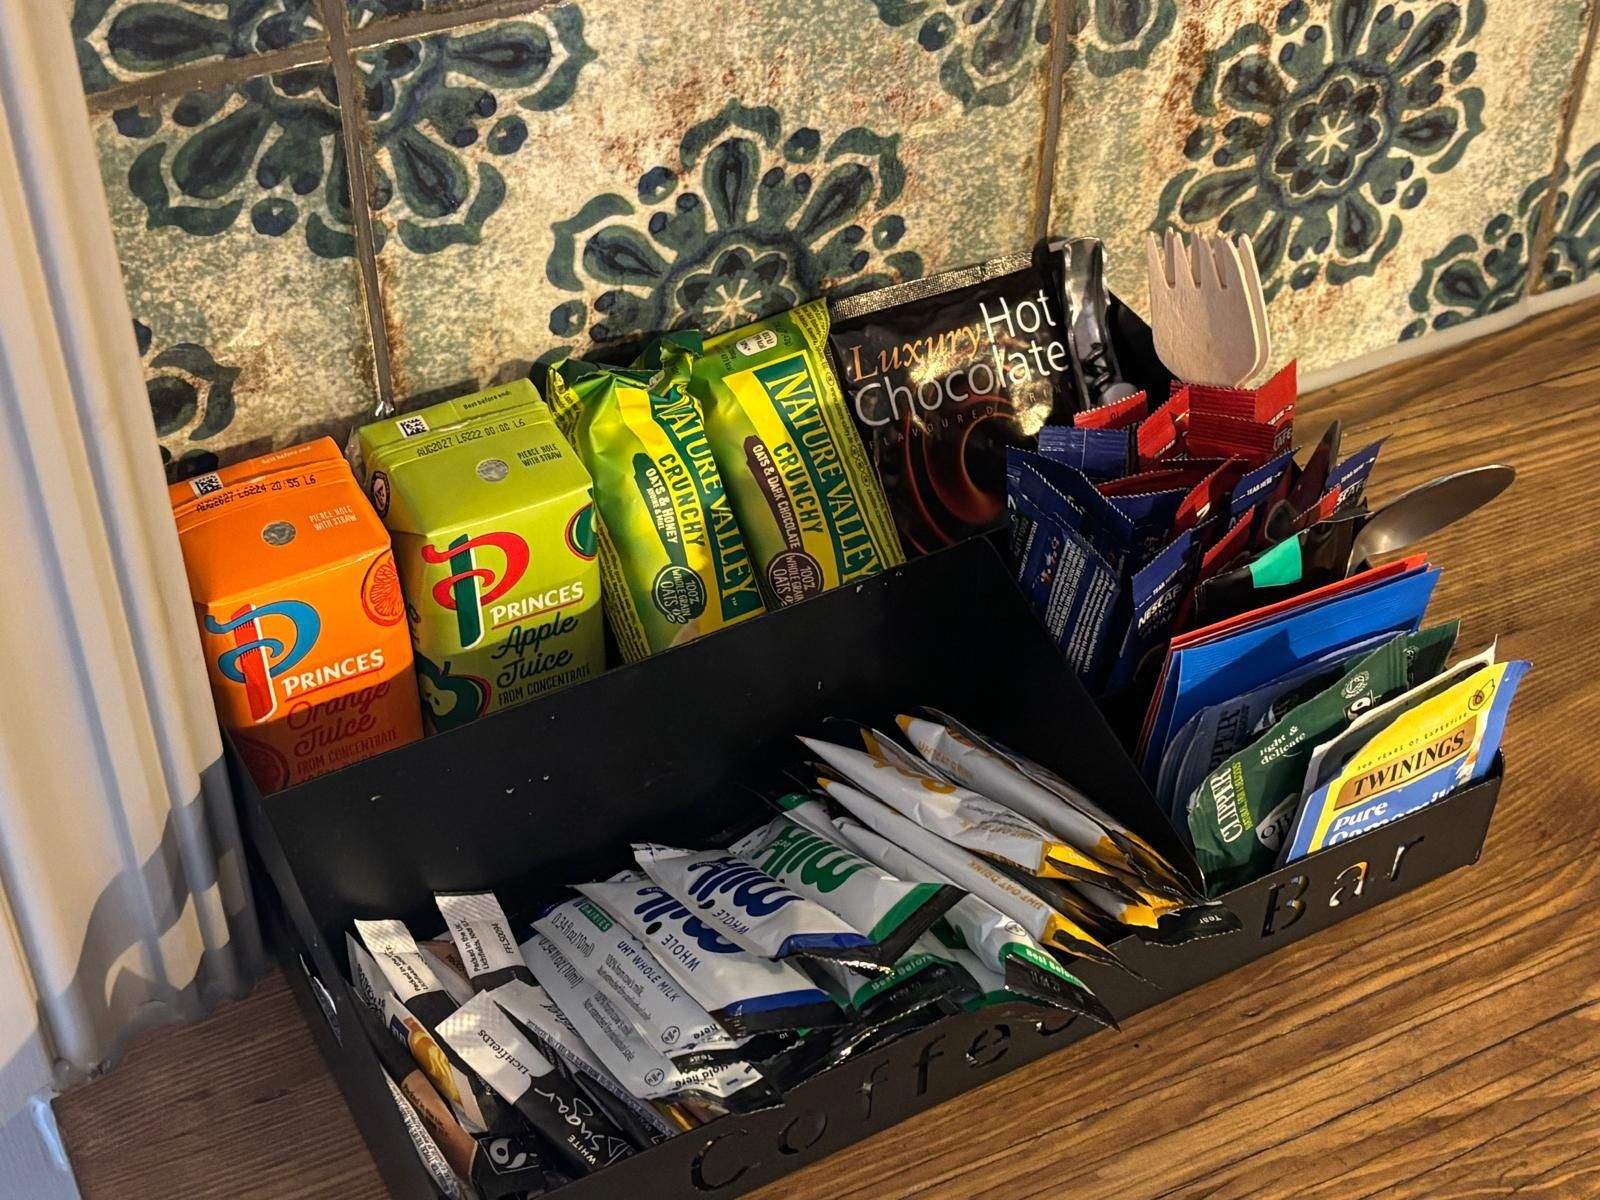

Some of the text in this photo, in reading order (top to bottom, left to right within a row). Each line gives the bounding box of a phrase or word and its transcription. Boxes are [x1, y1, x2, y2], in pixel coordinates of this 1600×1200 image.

[979, 289, 1057, 344] Hot
[850, 323, 982, 383] Luxury
[855, 339, 1069, 427] Chocolate
[869, 406, 994, 450] FLAVOURED
[517, 447, 540, 460] PIERCE
[521, 450, 564, 468] WITH STRAW
[654, 397, 758, 601] NATURE VALLEY
[752, 444, 802, 551] OATS & DARK CHOCOLATE
[765, 369, 843, 484] NATURE
[827, 479, 881, 585] VALLEY
[773, 442, 824, 534] CRUNCHY
[645, 467, 679, 545] OATS & HONEY
[658, 453, 706, 547] CRUNCHY
[772, 568, 789, 595] OATS
[785, 555, 799, 581] WHOLE
[490, 581, 585, 625] PRINCES
[660, 580, 676, 606] OATS
[490, 611, 579, 660] Apple
[281, 648, 385, 697] PRINCES
[496, 649, 574, 689] Juice
[498, 663, 592, 706] FROM CONCENTRATE
[287, 680, 393, 731] Orange
[293, 712, 377, 757] Juice
[296, 755, 326, 776] FROM
[328, 727, 398, 764] CONCENTRATE
[1260, 725, 1299, 757] light &
[1260, 732, 1307, 766] delicate
[1377, 744, 1404, 762] YEARS
[1408, 737, 1420, 748] OF
[1424, 713, 1469, 740] EXPERTISE
[1354, 729, 1465, 798] TWININGS
[1210, 768, 1243, 843] CLIPPER
[968, 860, 1044, 910] UHT OAT DRINK
[1261, 836, 1425, 938] Bar
[551, 912, 570, 931] 0.34
[578, 903, 613, 932] DAIRIES
[713, 909, 751, 935] WHOLE
[466, 948, 479, 972] Packed
[617, 939, 679, 1003] UHT WHOLE MILK
[661, 932, 701, 973] WHOLE
[402, 971, 420, 993] Packed
[693, 1023, 720, 1041] here
[675, 1072, 702, 1087] here
[689, 1053, 715, 1063] Tear
[567, 1134, 598, 1165] WHITE
